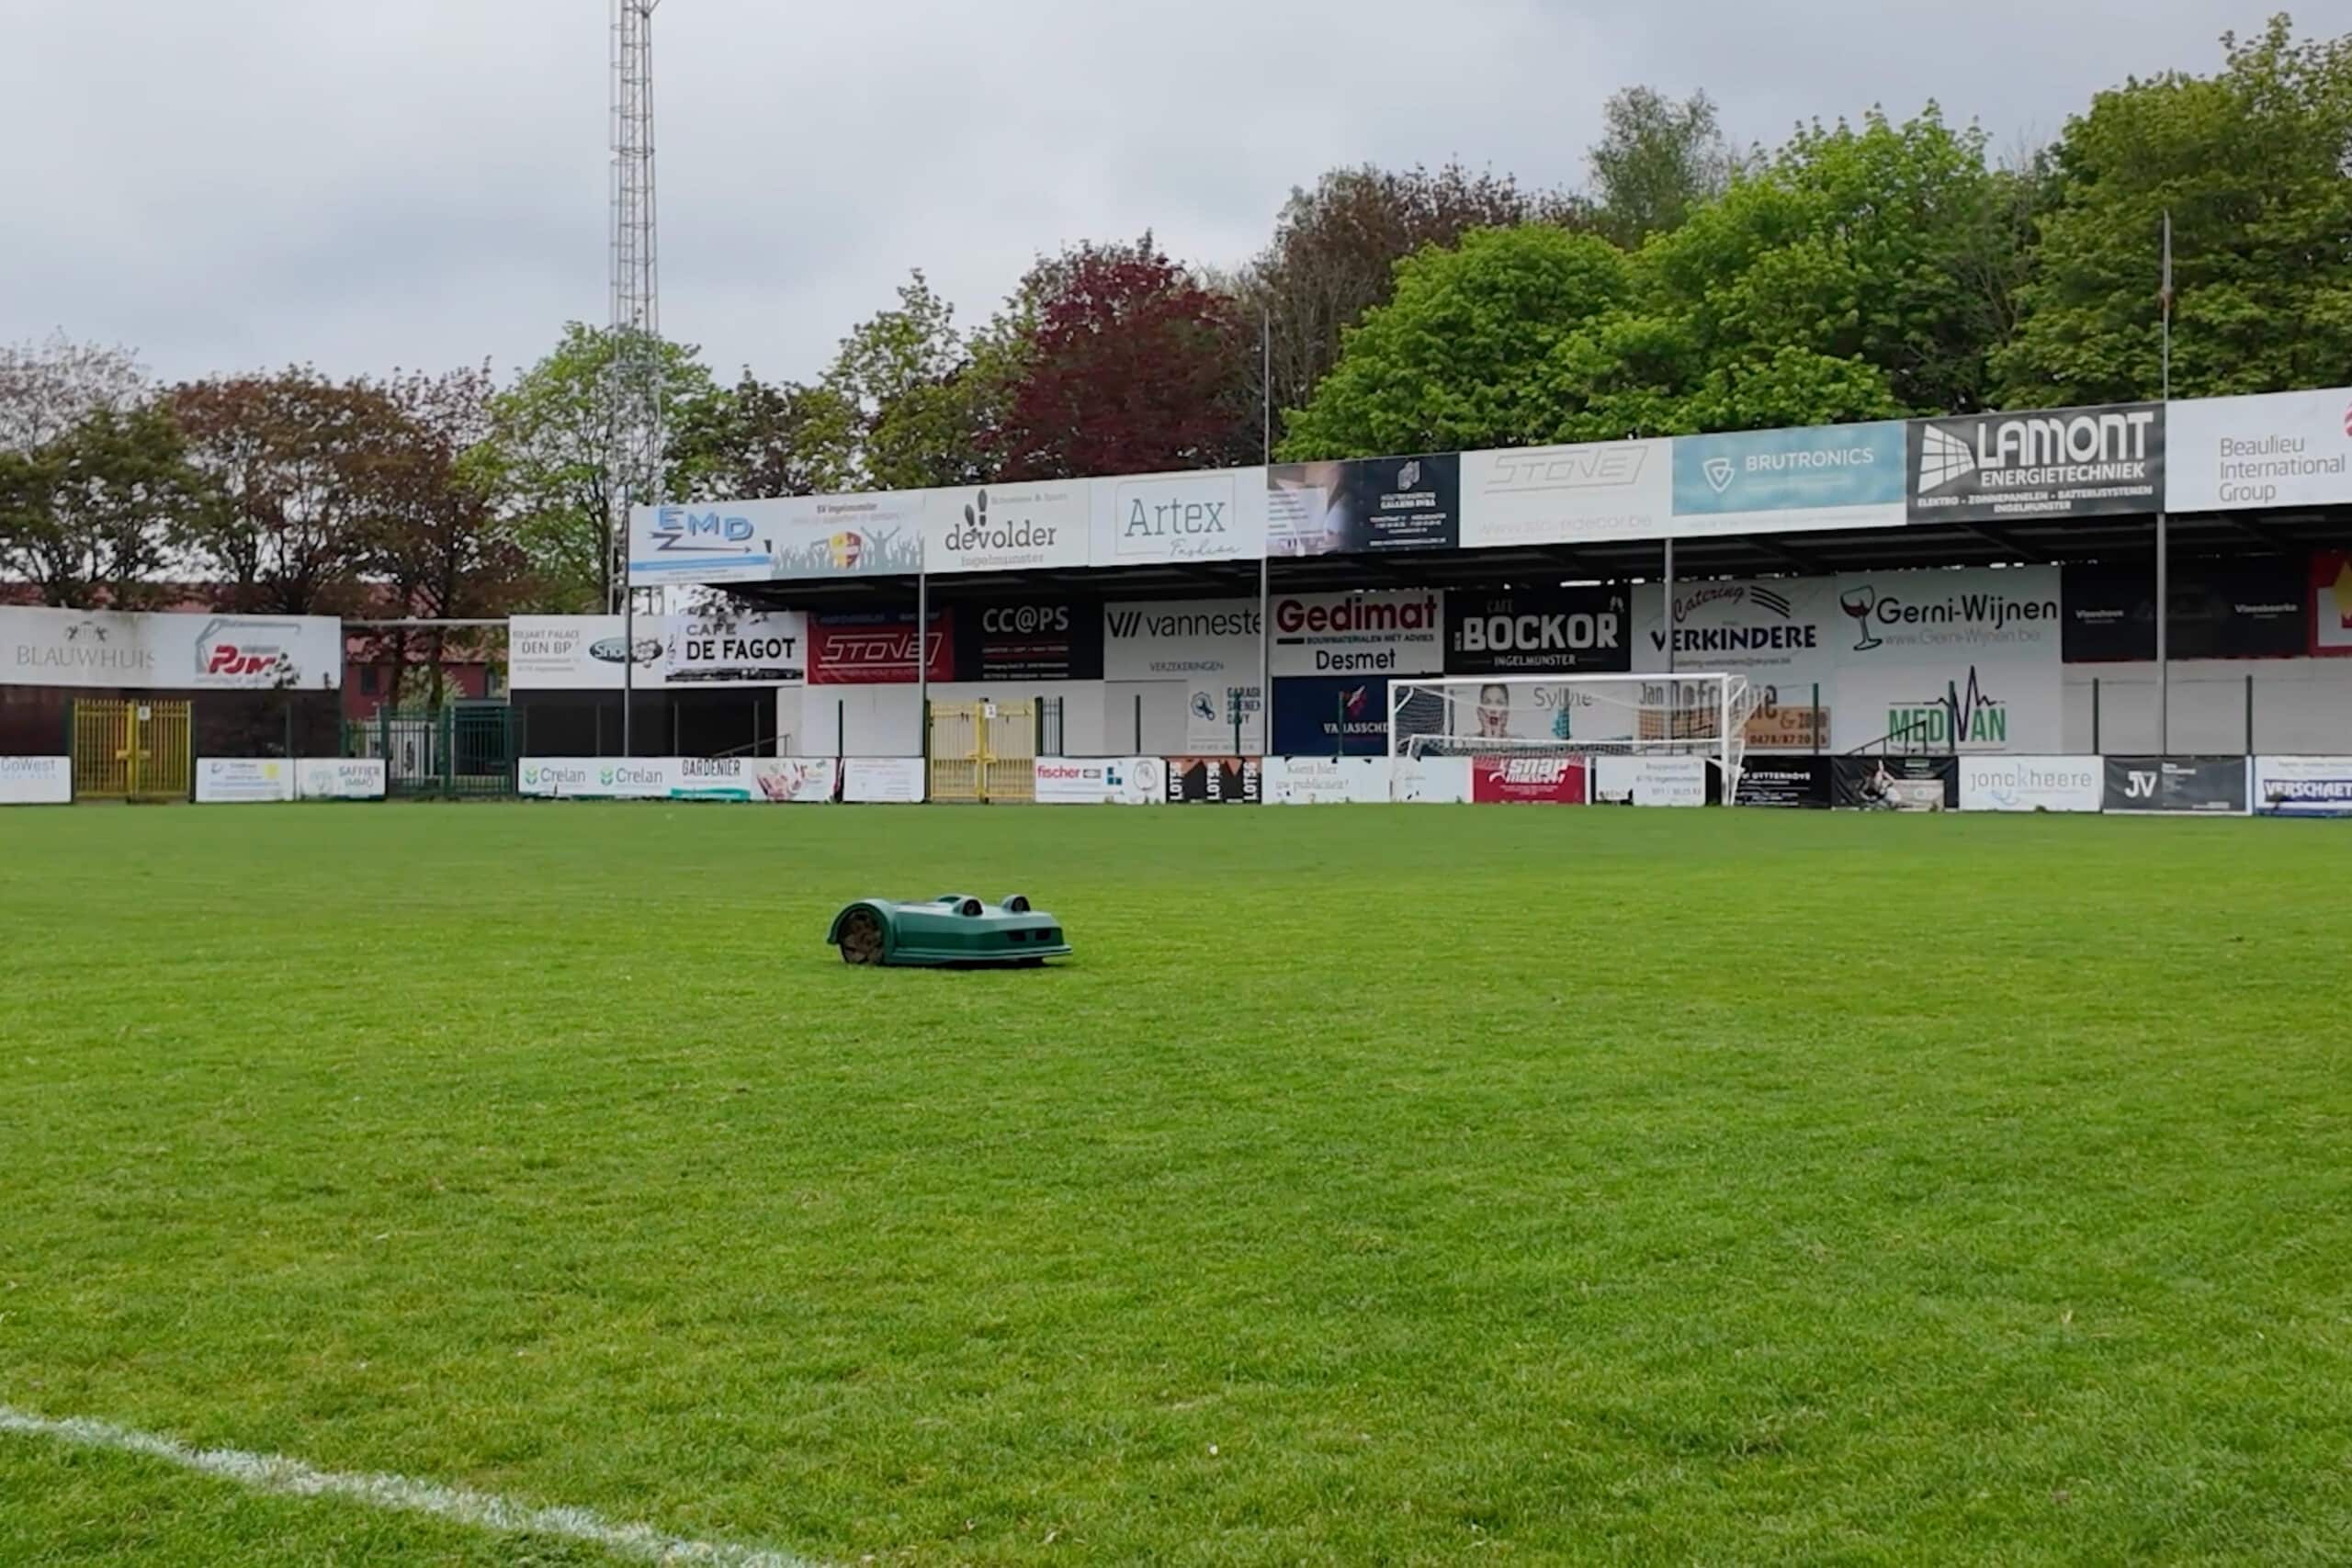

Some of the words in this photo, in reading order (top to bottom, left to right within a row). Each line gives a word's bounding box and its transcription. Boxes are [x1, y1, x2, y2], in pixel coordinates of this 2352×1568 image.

[1978, 411, 2154, 468] LAMONT
[2220, 436, 2305, 457] Beaulieu
[1747, 447, 1875, 471] BRUTRONICS
[2220, 454, 2346, 479] International
[1980, 461, 2145, 488] ENERGIETECHNIEK
[1917, 497, 1959, 508] ELEKTRO
[2219, 482, 2277, 504] Group
[658, 506, 753, 542] EMD
[1125, 497, 1227, 537] Artex
[944, 519, 1057, 551] devolder
[1276, 595, 1438, 634] Gedimat
[1674, 583, 1745, 623] Catering
[1876, 593, 2058, 630] Gerni-Wijnen
[982, 605, 1069, 633] CC@PS
[1463, 612, 1619, 652] BOCKOR
[1650, 626, 1817, 651] VERKINDERE
[16, 644, 155, 671] BLAUWHUIS
[521, 641, 549, 654] DEN
[686, 641, 715, 661] DE
[722, 637, 796, 660] FAGOT
[1316, 649, 1396, 671] Desmet
[1494, 654, 1577, 667] INGELMUNSTER
[540, 767, 586, 784] Crelan
[616, 767, 663, 785] Crelan
[1037, 765, 1081, 779] fischer
[2124, 771, 2158, 798] JV
